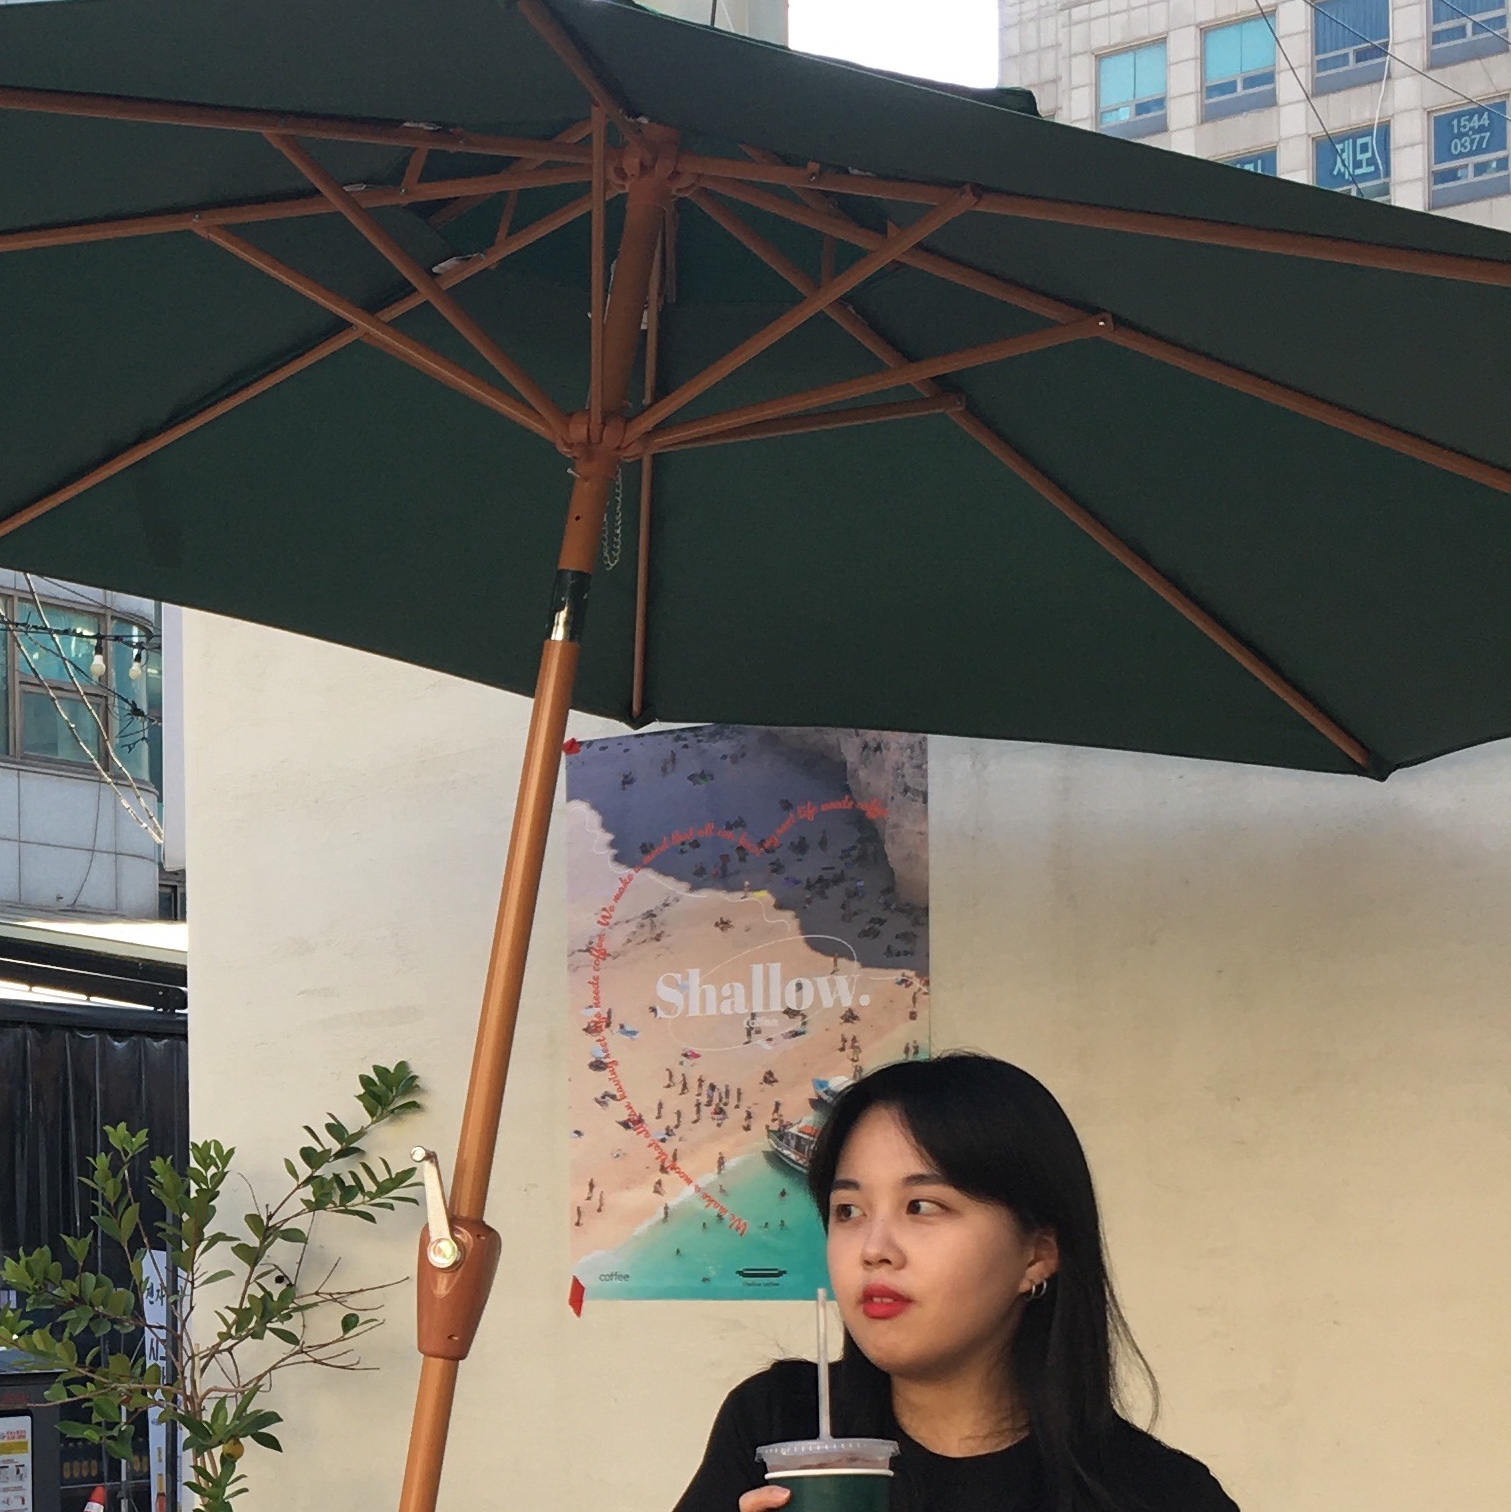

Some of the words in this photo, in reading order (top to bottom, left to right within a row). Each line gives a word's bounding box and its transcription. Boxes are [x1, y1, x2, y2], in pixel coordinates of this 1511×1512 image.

[1451, 111, 1490, 134] 1544
[1450, 131, 1491, 155] 0377
[1333, 135, 1375, 181] 제모
